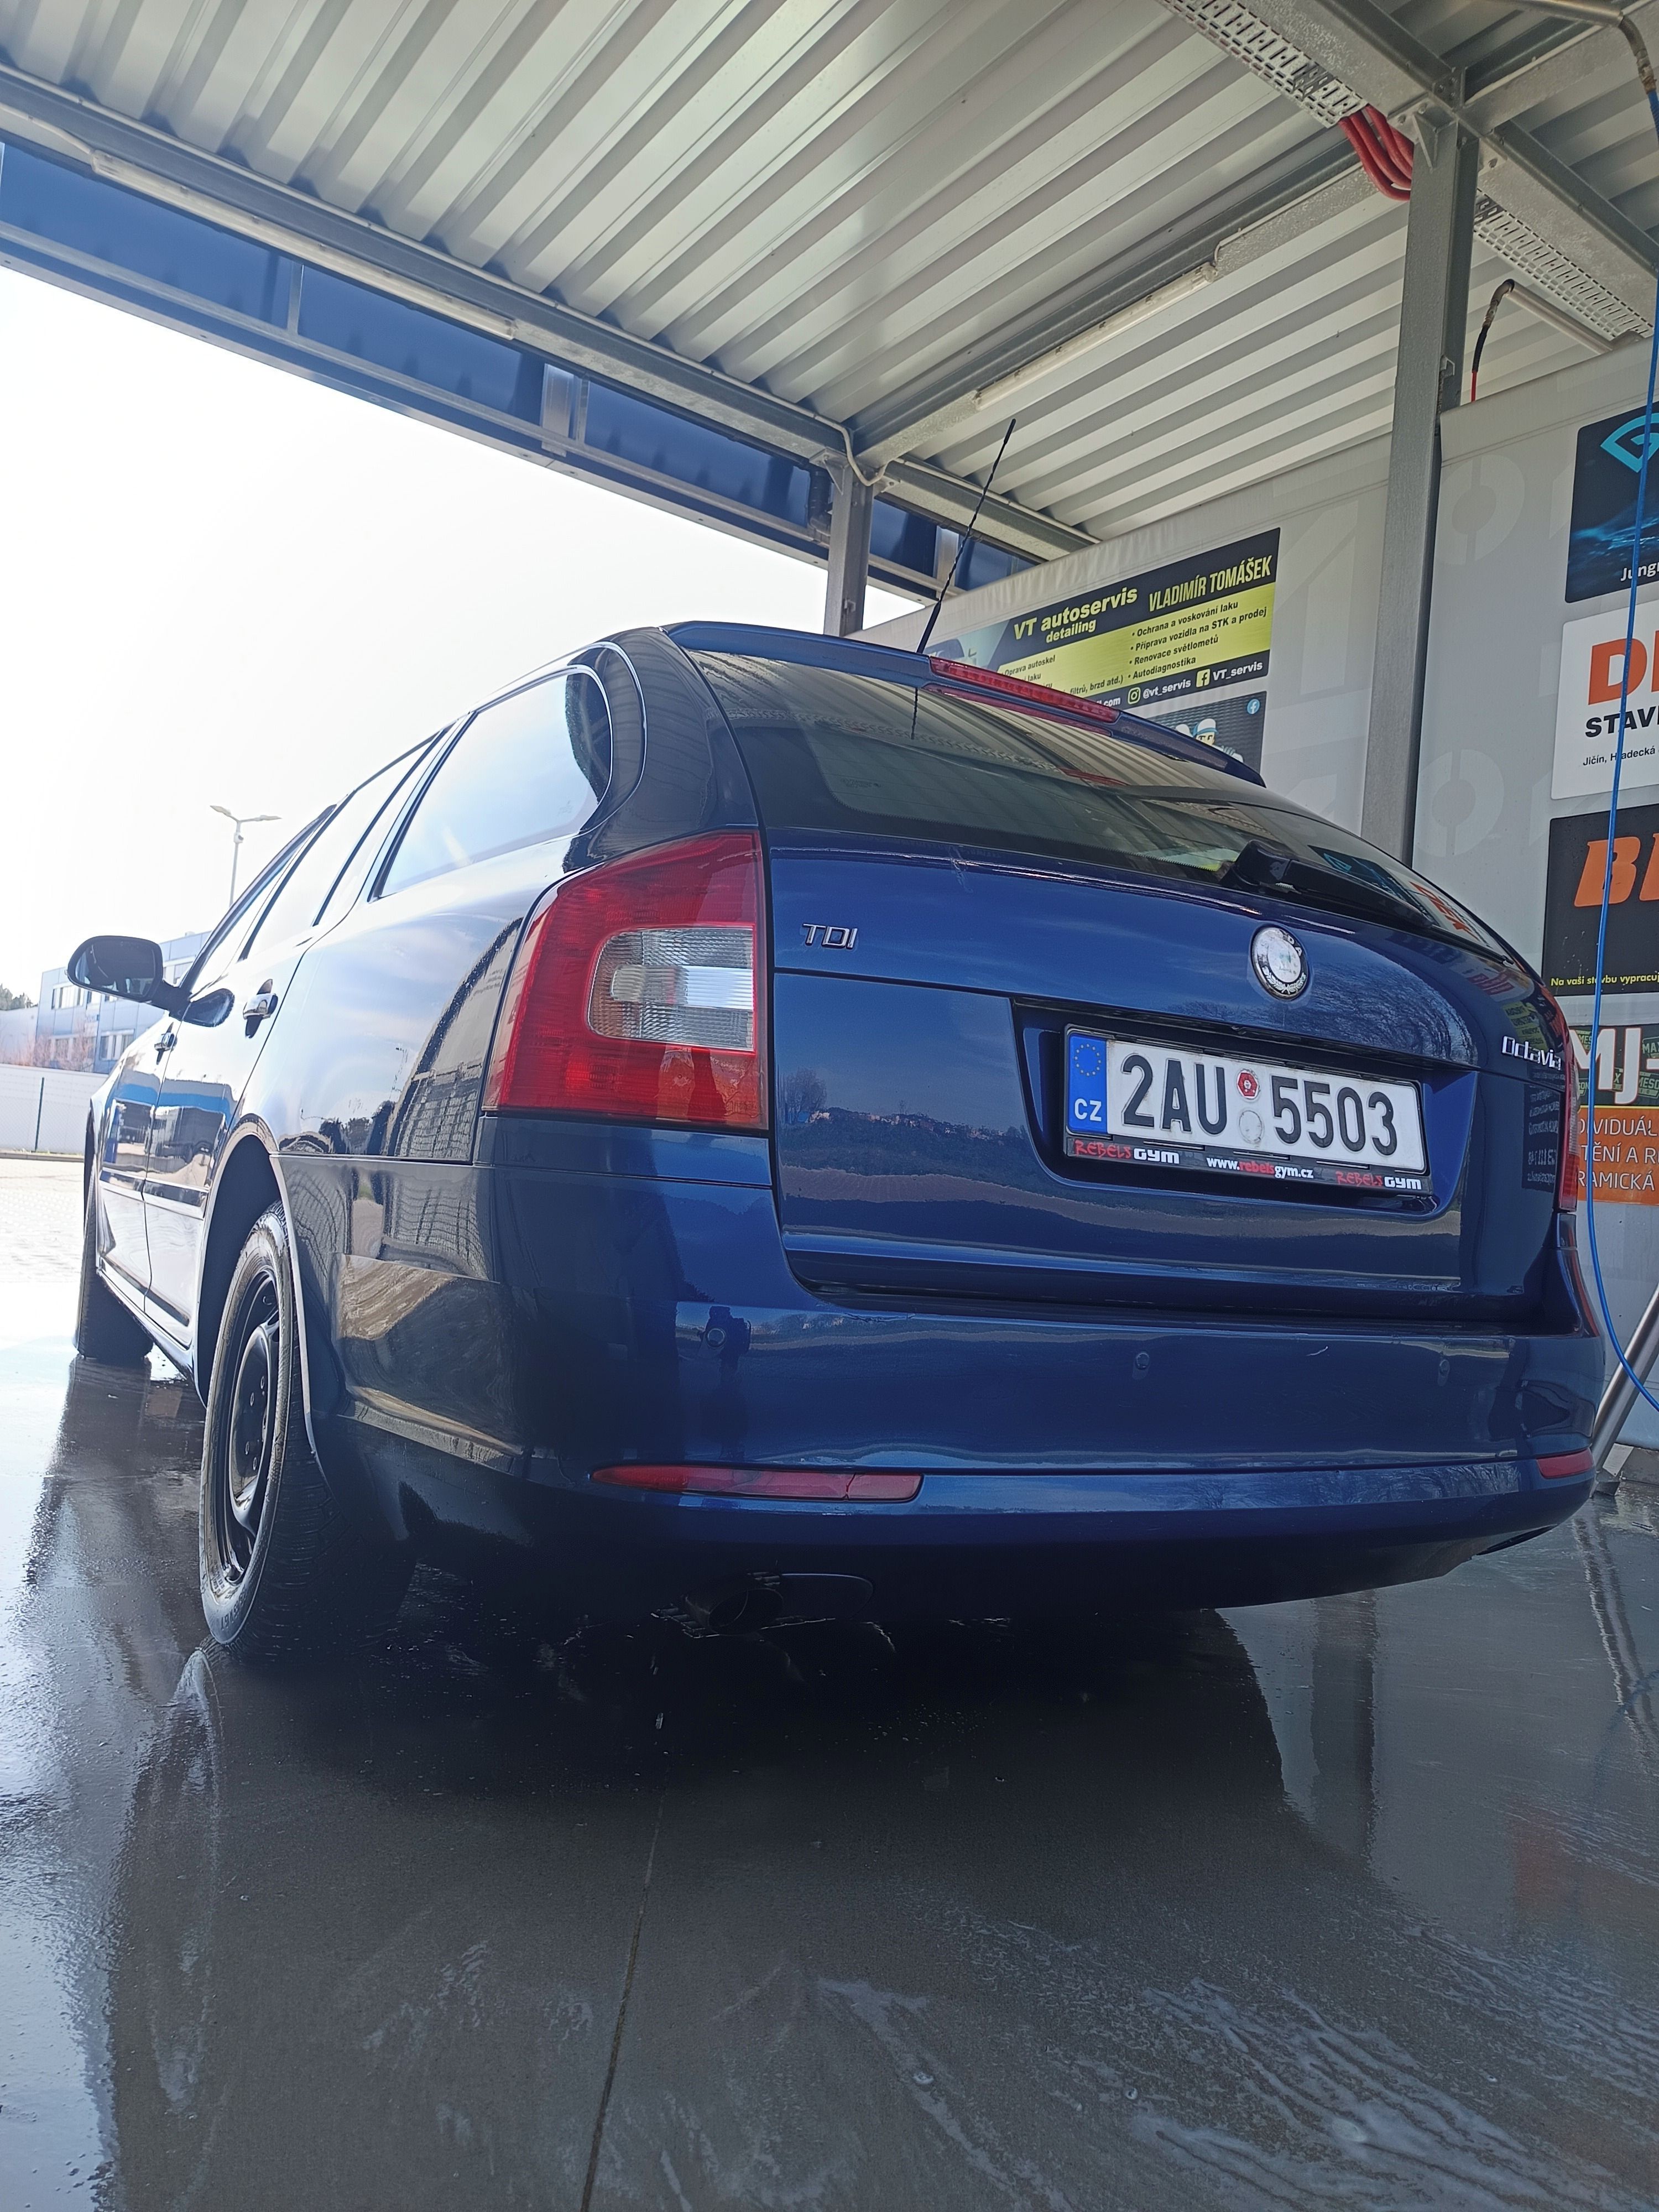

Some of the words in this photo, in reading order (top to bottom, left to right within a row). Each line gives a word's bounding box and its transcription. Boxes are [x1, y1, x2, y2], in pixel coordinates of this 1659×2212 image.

[1149, 575, 1207, 612] VLADIMÍR
[1210, 555, 1272, 593] TOMÁŠEK
[1014, 617, 1037, 640] VT
[1041, 587, 1138, 632] autoservis
[1137, 621, 1168, 637] Ochrana
[1178, 608, 1218, 624] voskování
[1220, 602, 1238, 613] laku
[1046, 620, 1096, 643] detailing
[1135, 637, 1167, 651] Příprava
[1169, 627, 1197, 642] vozidla
[1199, 625, 1209, 633] na
[1212, 618, 1229, 630] STK
[1239, 607, 1267, 624] prodej
[1134, 649, 1171, 665] Renovace
[1173, 634, 1218, 654] světlometů
[1027, 655, 1056, 670] autoskel
[1133, 657, 1196, 679] Autodiagnostika
[1213, 661, 1263, 681] VT_servis
[1588, 630, 1659, 705] D
[1090, 680, 1105, 691] brzd
[1107, 675, 1123, 686] atd.)
[1143, 679, 1191, 699] @vt_servis
[1585, 706, 1659, 738] STAV
[1583, 754, 1607, 766] Jičín,
[1610, 745, 1656, 761] Hadecká
[1574, 833, 1659, 907] B
[802, 923, 858, 950] TDI
[1551, 978, 1564, 986] Na
[1566, 975, 1585, 985] vaši
[1502, 1036, 1561, 1071] Octavia
[1074, 1098, 1102, 1122] CZ
[1120, 1054, 1228, 1135] 2AU
[1270, 1074, 1397, 1156] 5503
[1206, 1157, 1314, 1179] www.rebelsgym.cz
[1626, 1147, 1639, 1164] A
